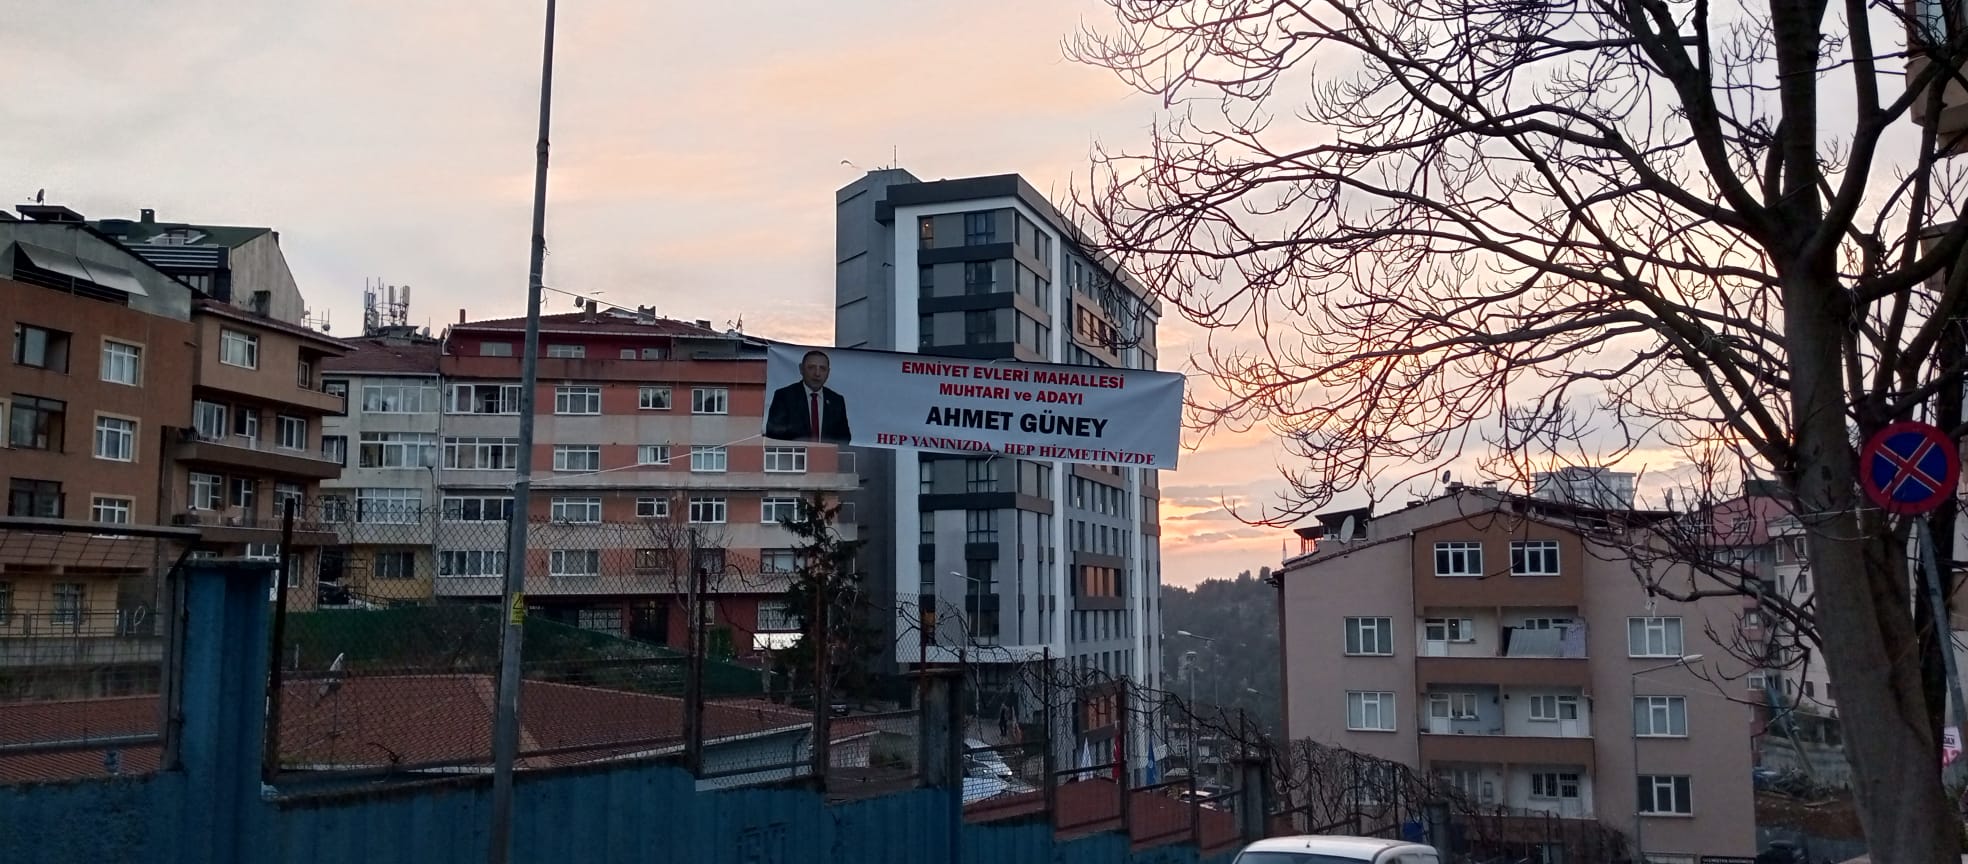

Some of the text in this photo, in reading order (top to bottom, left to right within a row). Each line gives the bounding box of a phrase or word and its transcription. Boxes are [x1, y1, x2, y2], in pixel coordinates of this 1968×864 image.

[902, 361, 1125, 389] EMNİYET EVLERİ MAHALLESİ
[939, 383, 1083, 405] MUHTARI ve ADAYI
[925, 406, 1108, 438] AHMET GÜNEY
[877, 433, 908, 446] HEP
[1004, 443, 1035, 456] HEP
[1039, 444, 1156, 465] HİZMETİNİZDE
